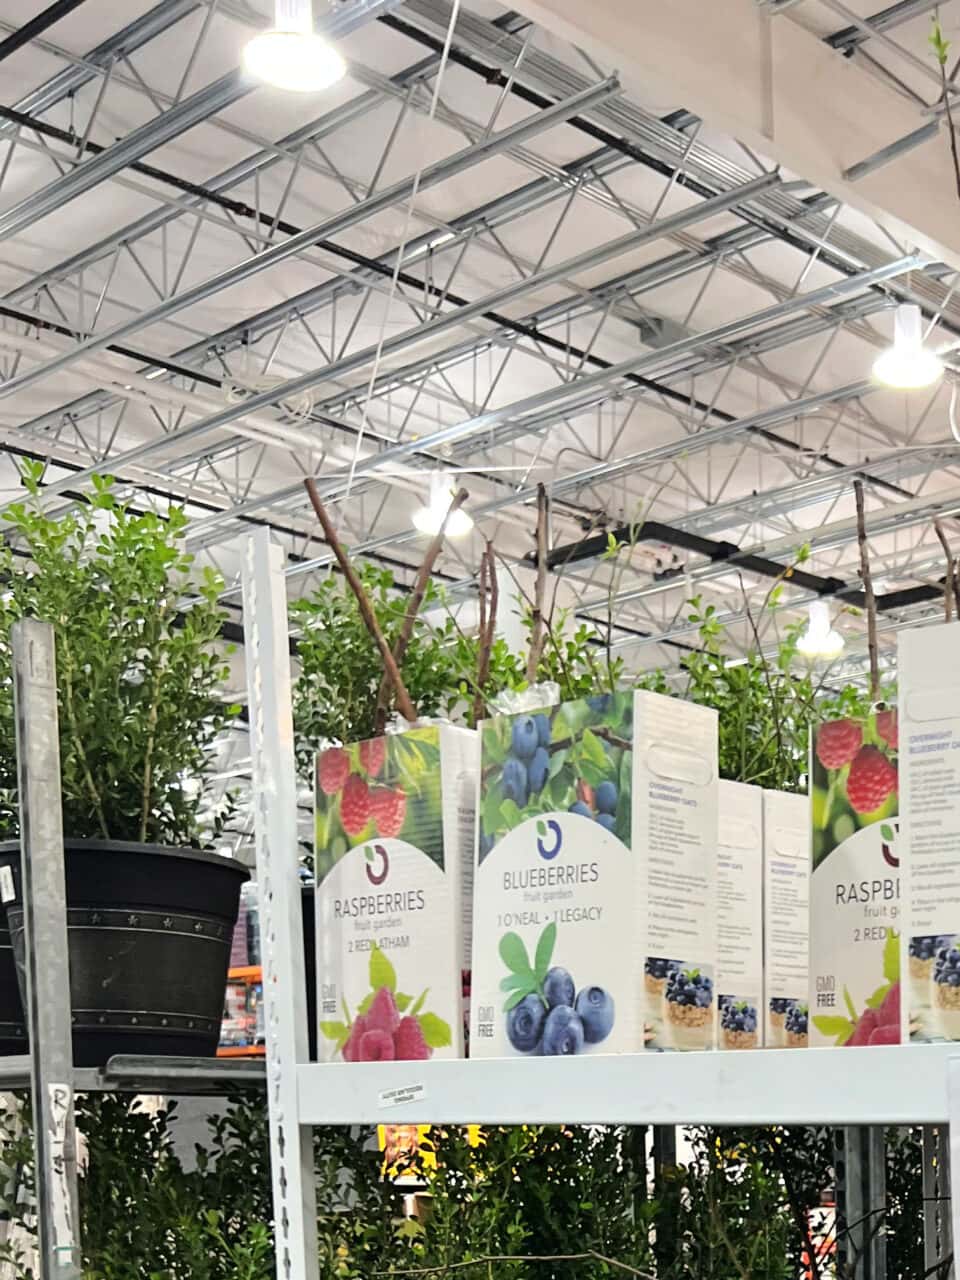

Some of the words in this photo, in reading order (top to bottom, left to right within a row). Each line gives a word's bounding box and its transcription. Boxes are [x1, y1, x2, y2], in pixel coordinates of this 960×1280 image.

[503, 862, 599, 890] BLUEBERRIES
[835, 878, 900, 905] RASPB
[333, 889, 425, 919] RASPBERRIES
[560, 907, 603, 923] LEGACY
[853, 929, 861, 942] 2
[863, 927, 888, 941] RED
[816, 993, 836, 1008] FREE
[478, 1024, 494, 1038] FREE
